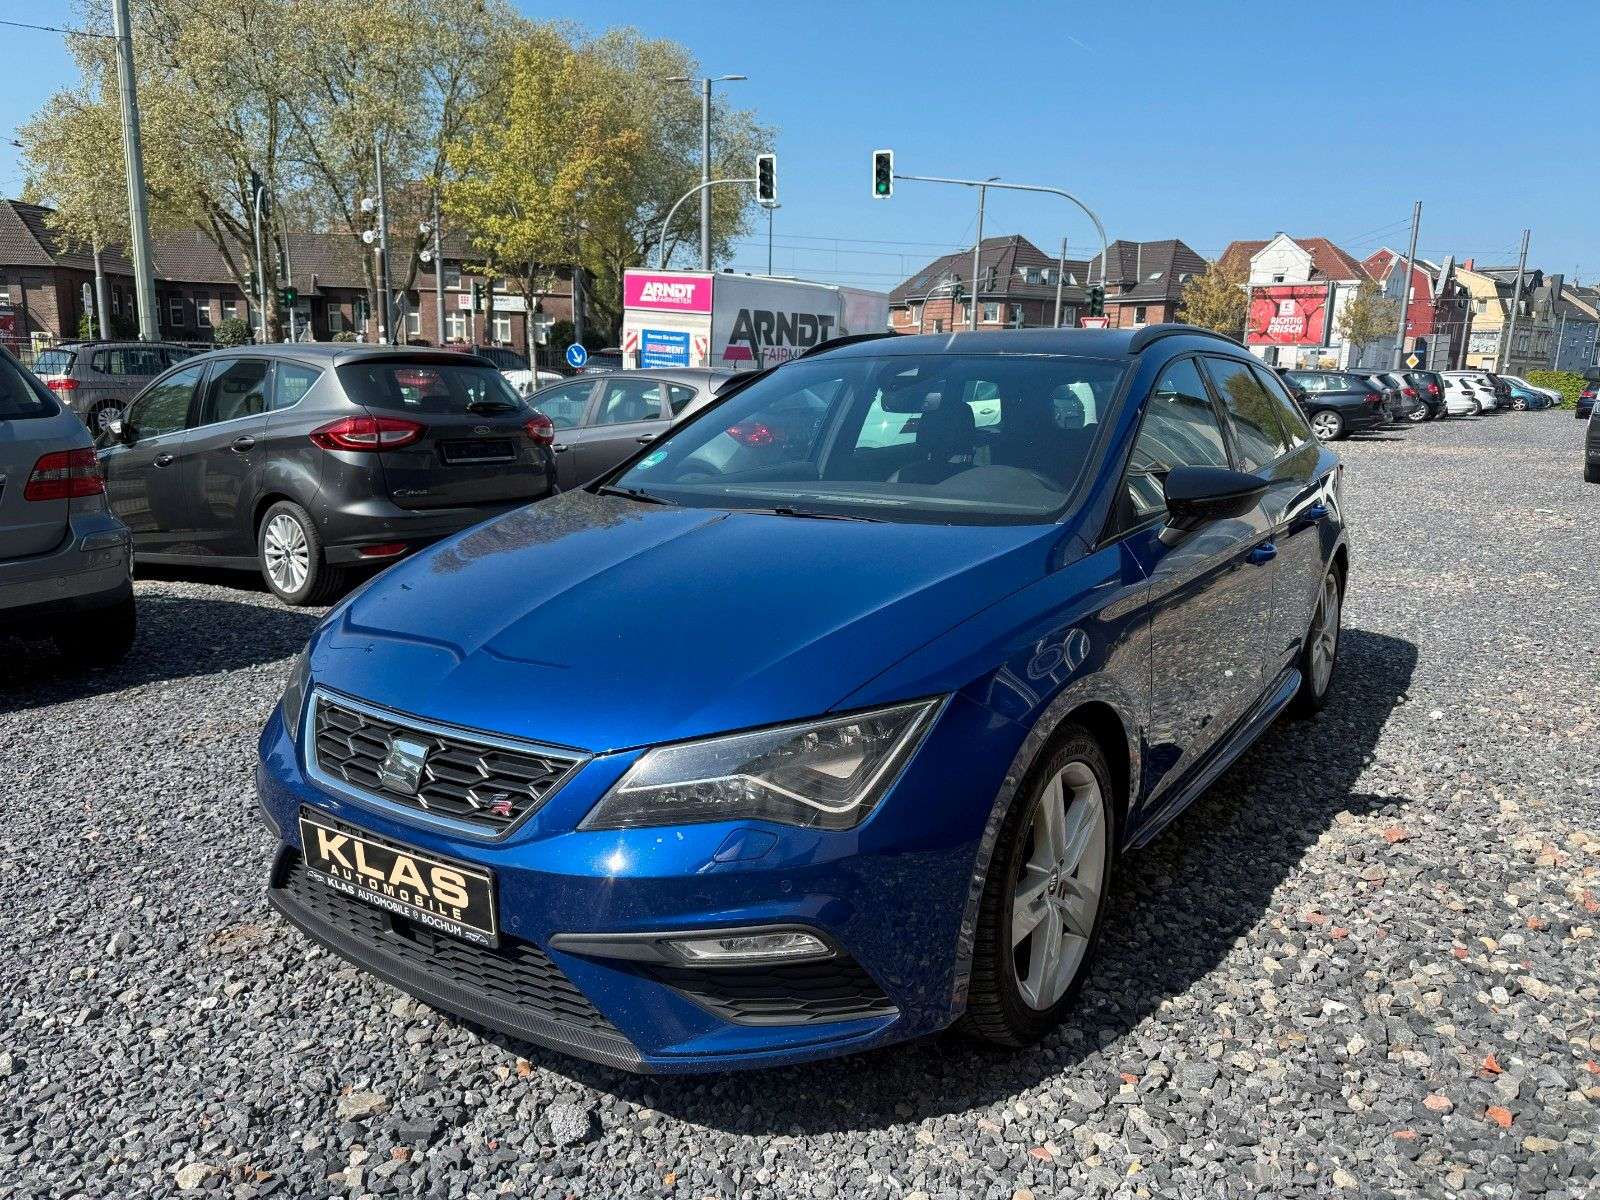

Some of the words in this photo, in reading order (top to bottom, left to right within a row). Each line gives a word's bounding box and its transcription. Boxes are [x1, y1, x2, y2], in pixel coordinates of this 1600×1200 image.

[640, 282, 695, 301] ARNDT
[723, 308, 835, 360] ARNDT
[1267, 324, 1304, 334] FRISCH
[1271, 316, 1302, 325] RICHTIG
[317, 827, 469, 909] KLAS
[331, 864, 462, 921] AUTOMOBILE
[327, 877, 355, 895] KLAS
[357, 888, 411, 917] AUTOMOBILE
[421, 913, 462, 937] BOCHUM
